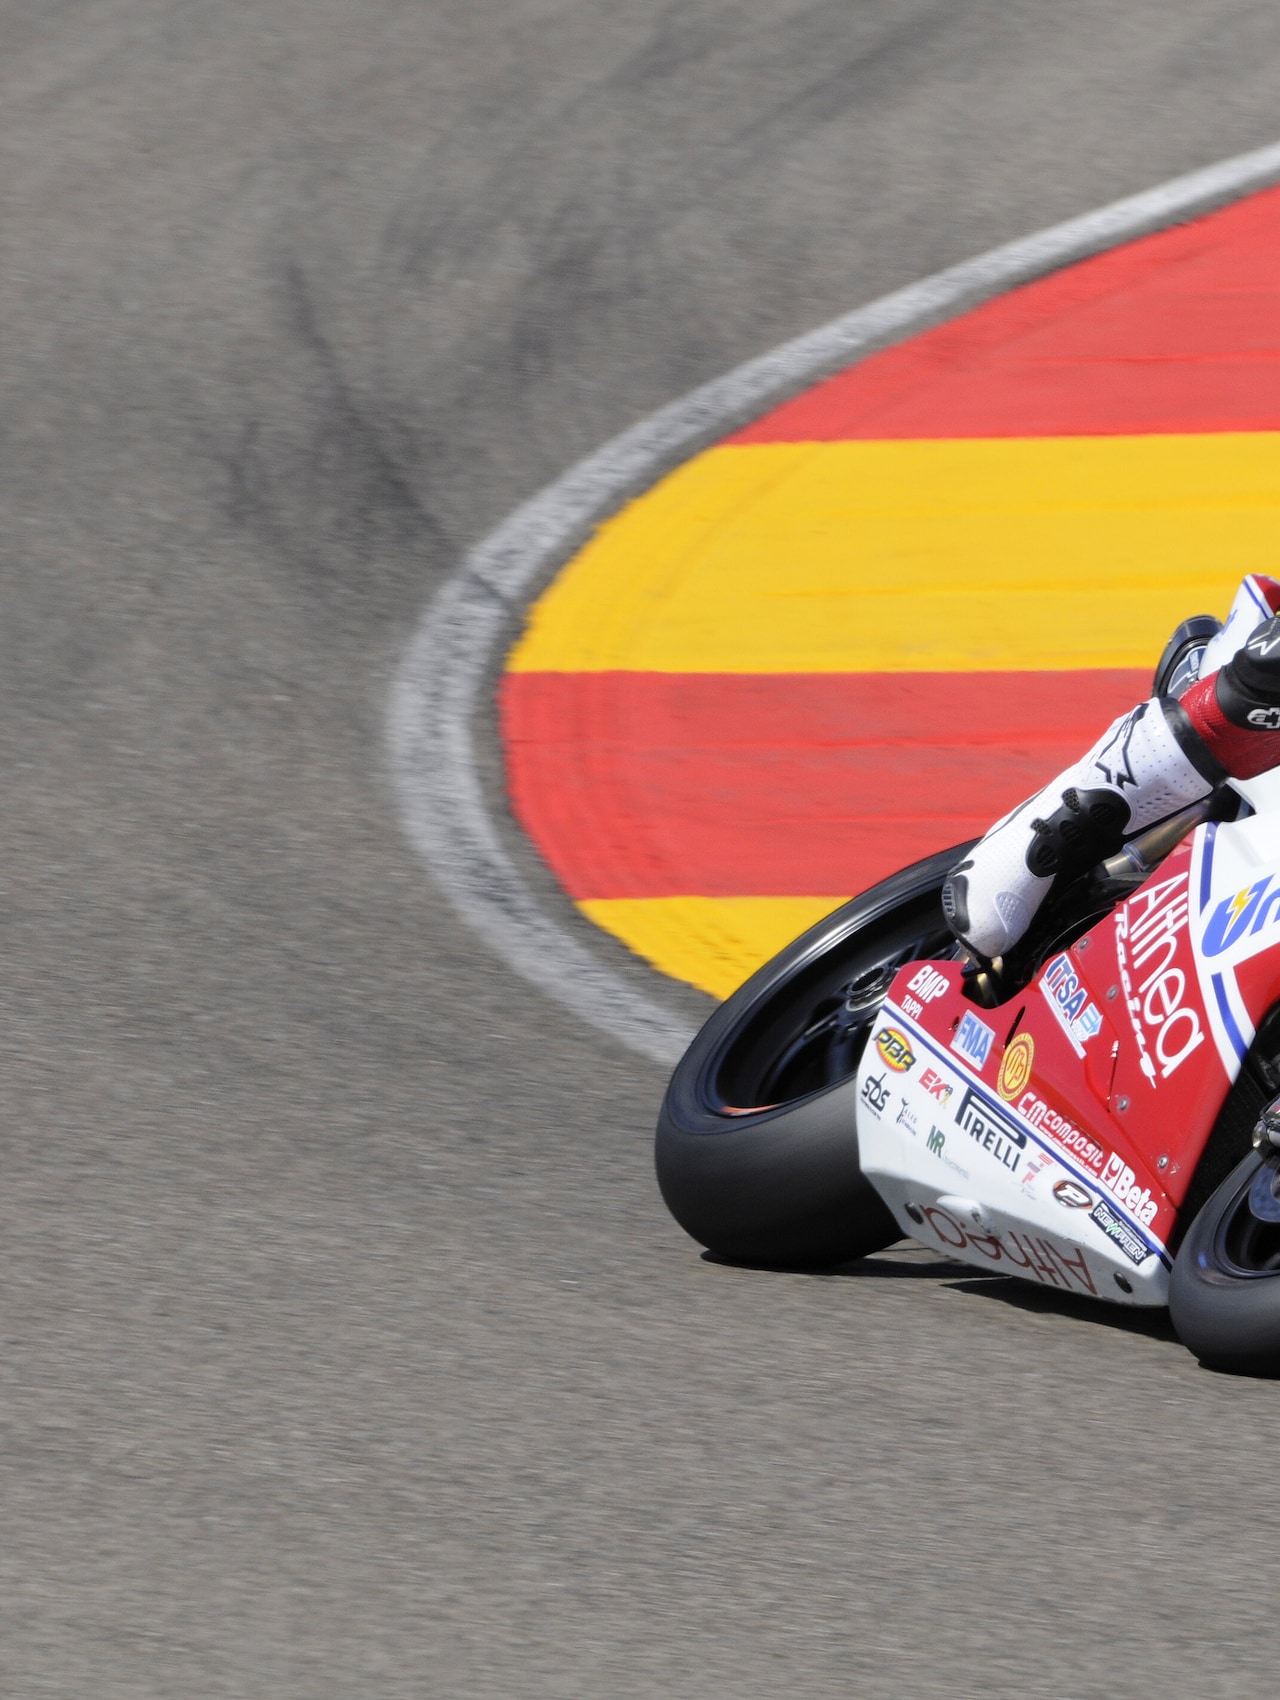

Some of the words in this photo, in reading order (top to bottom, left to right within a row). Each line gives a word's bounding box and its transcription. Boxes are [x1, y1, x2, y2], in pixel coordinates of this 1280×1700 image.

[906, 964, 950, 1004] BMP
[1045, 954, 1088, 1022] ITSA
[1114, 904, 1158, 1088] Racing
[1129, 872, 1204, 1079] Althea
[901, 994, 923, 1020] TAPPI
[872, 1028, 917, 1072] PBR
[954, 1013, 989, 1065] FMA
[918, 1067, 948, 1101] EK
[954, 1085, 1028, 1173] PIRELLI
[1113, 1165, 1159, 1227] Beta
